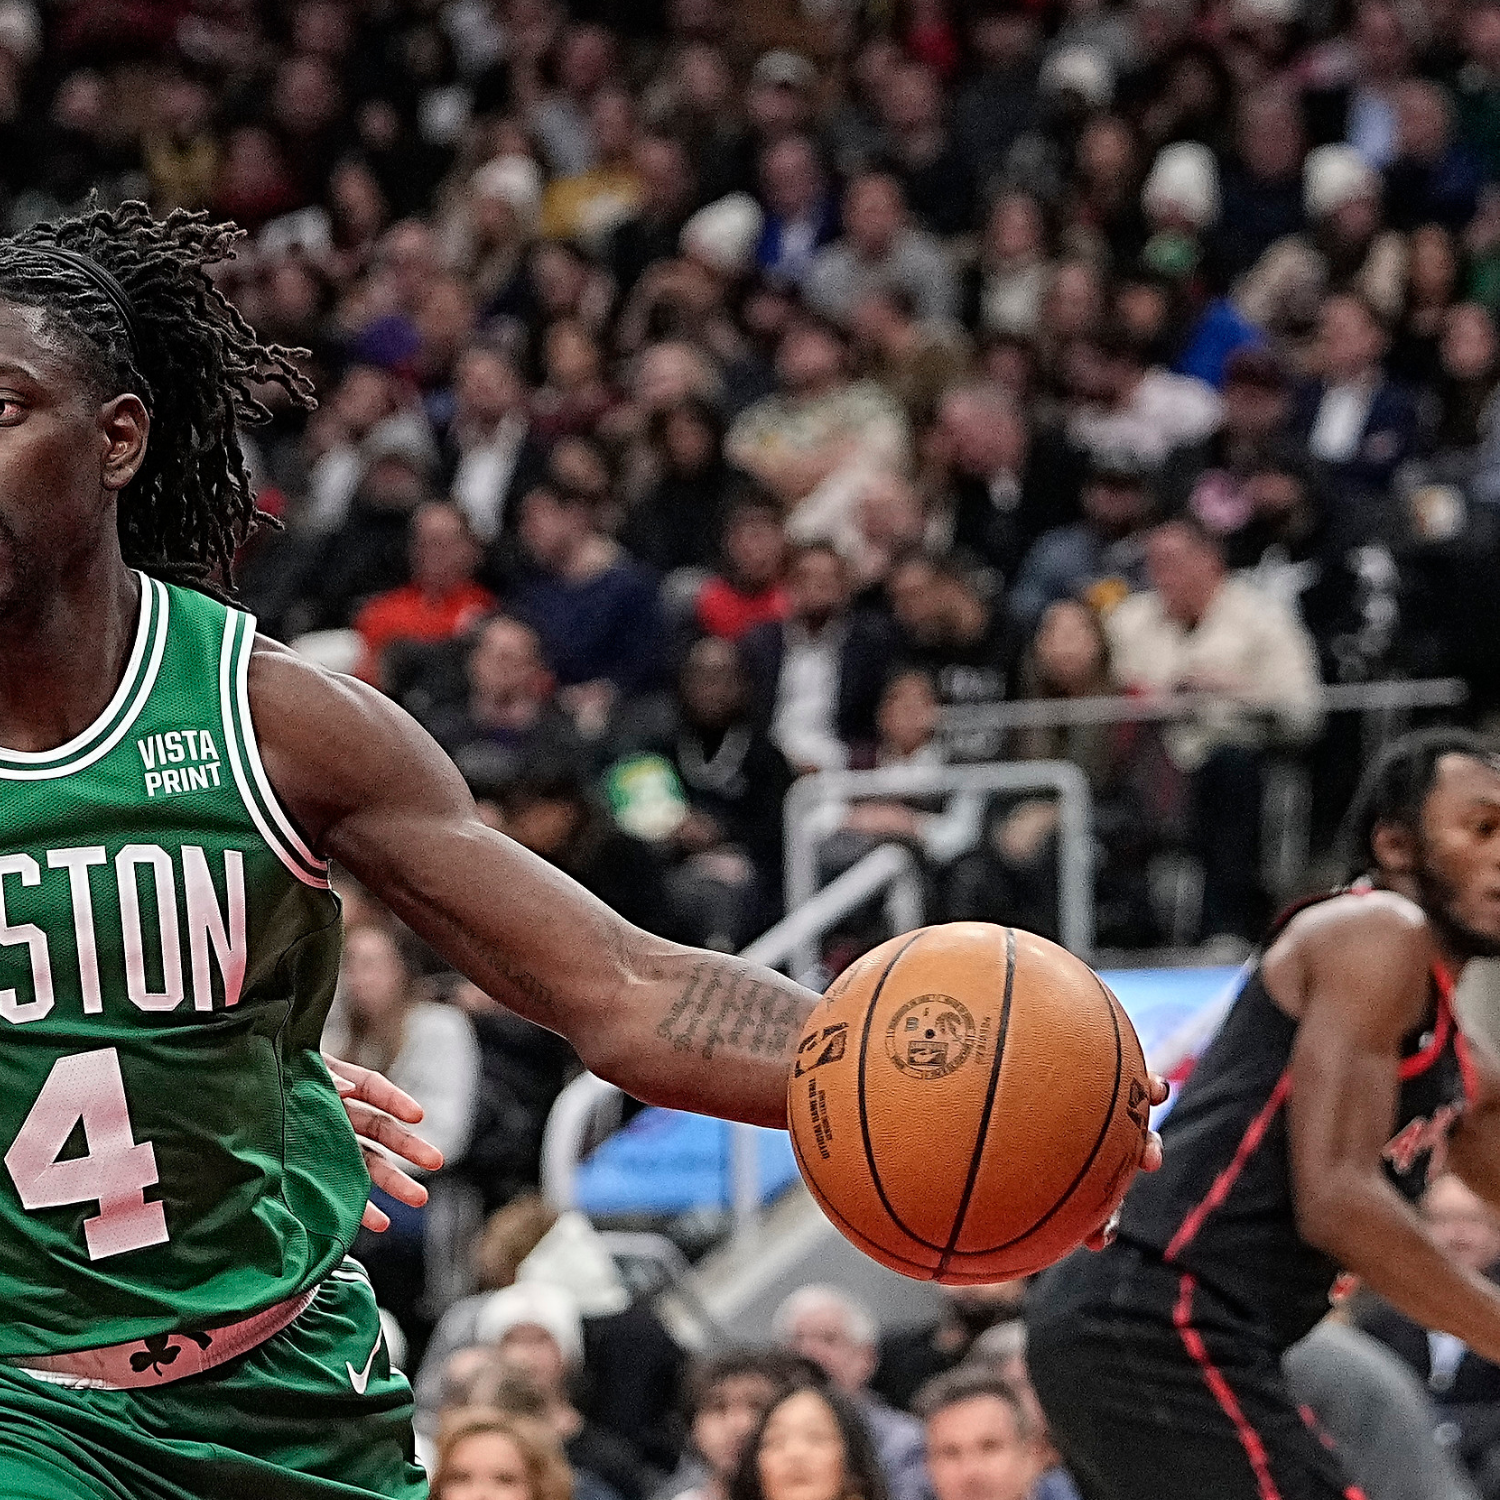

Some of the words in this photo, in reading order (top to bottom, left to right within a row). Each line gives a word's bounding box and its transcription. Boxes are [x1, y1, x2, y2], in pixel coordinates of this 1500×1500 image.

[137, 729, 220, 770] VISTA
[144, 760, 221, 797] PRINT
[4, 1047, 170, 1260] 4
